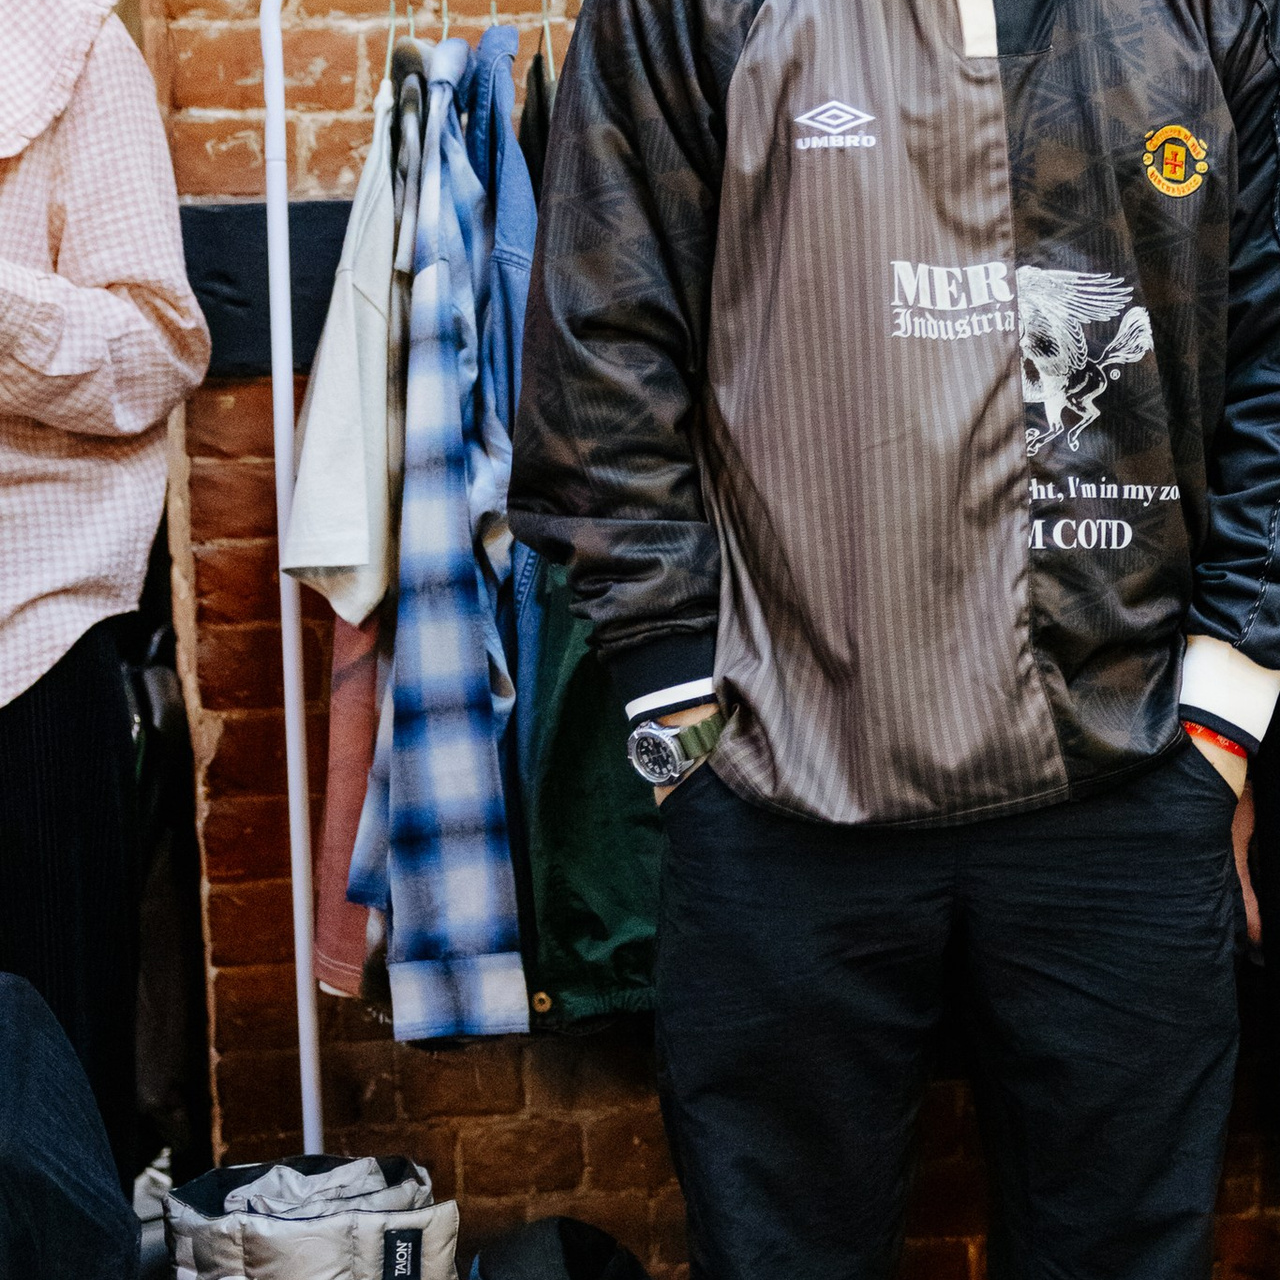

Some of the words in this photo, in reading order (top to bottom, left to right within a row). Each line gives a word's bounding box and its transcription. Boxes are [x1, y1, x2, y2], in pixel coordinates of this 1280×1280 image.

[796, 133, 877, 150] UMBRO
[890, 261, 1015, 311] MER
[892, 303, 1016, 341] Industria
[1100, 476, 1119, 499] in
[1122, 485, 1158, 507] my
[1159, 484, 1182, 501] zo
[1052, 518, 1133, 550] COTD
[394, 1242, 408, 1277] TAION
